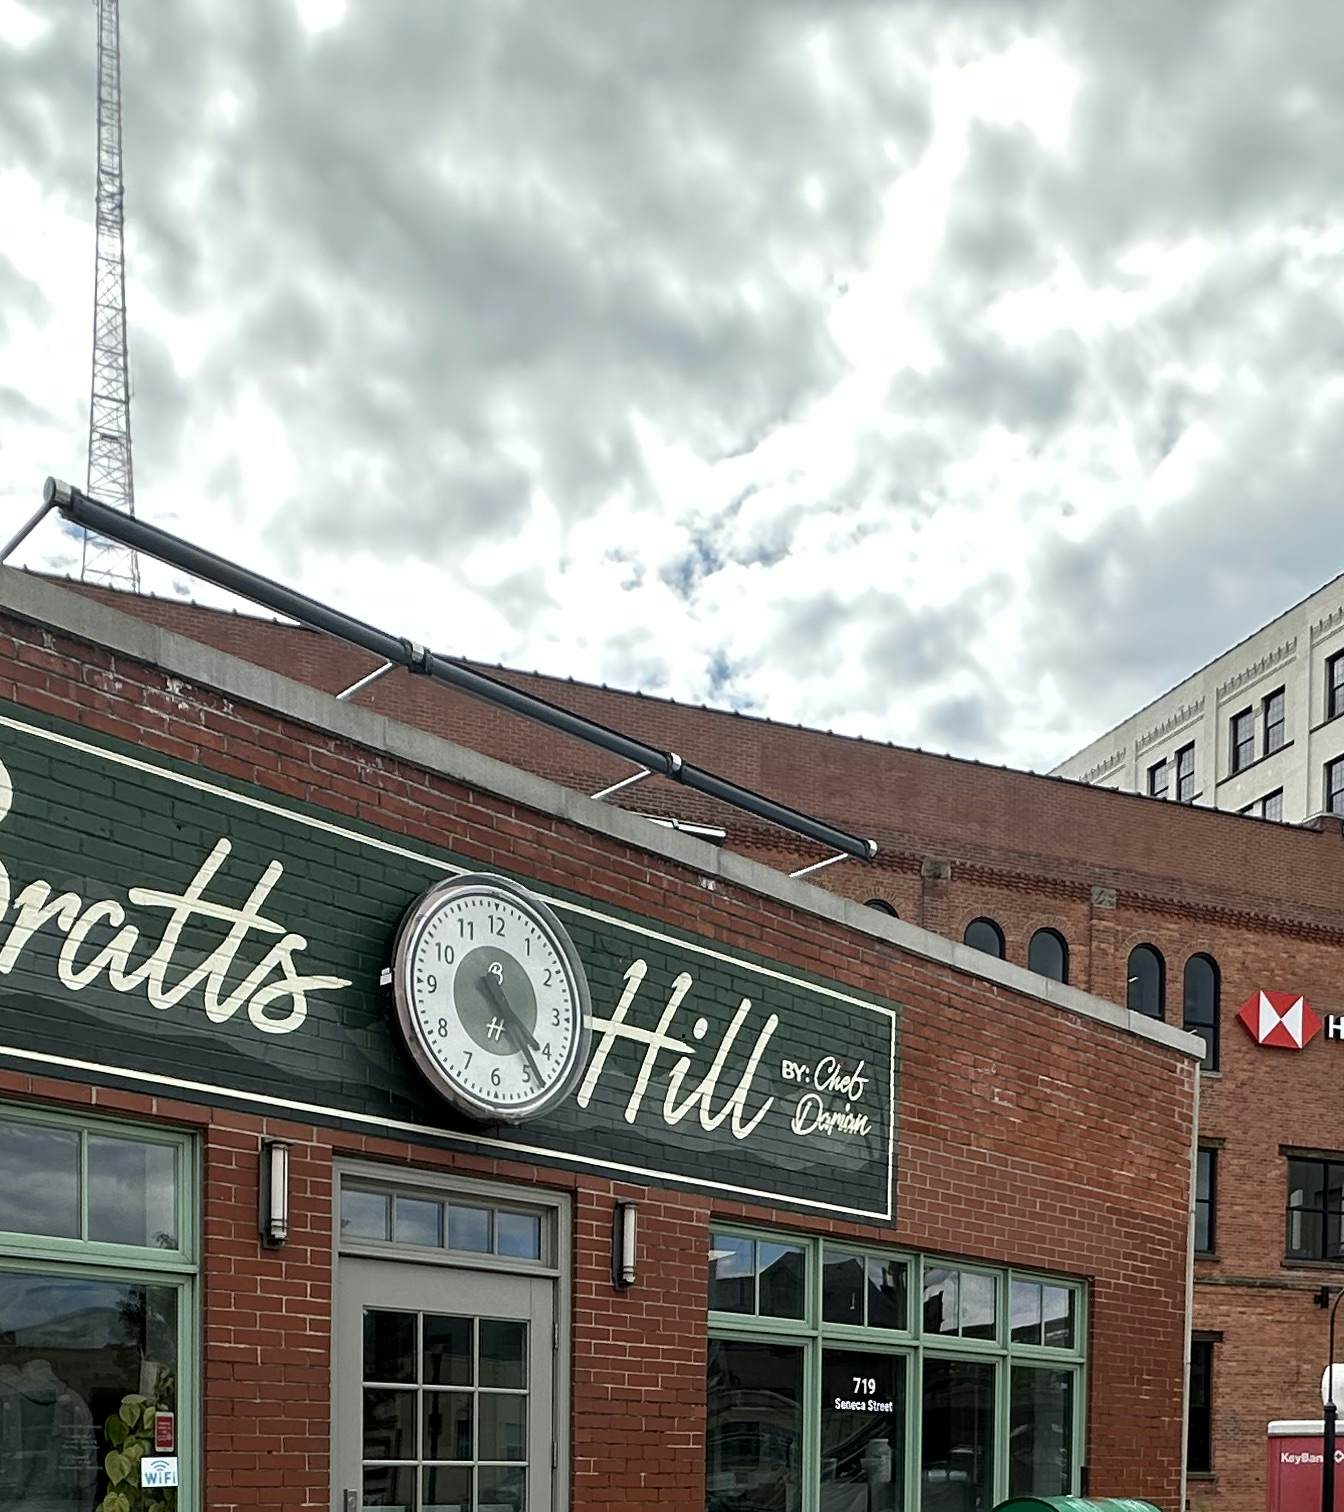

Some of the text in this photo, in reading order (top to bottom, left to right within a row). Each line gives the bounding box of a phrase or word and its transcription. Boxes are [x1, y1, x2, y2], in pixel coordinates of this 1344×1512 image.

[458, 918, 474, 940] 11
[488, 914, 506, 937] 12
[435, 942, 455, 965] 10
[525, 938, 532, 957] 1
[427, 975, 438, 994] 9
[544, 968, 553, 988] 2
[552, 1008, 561, 1027] 3
[438, 1018, 449, 1038] 8
[486, 1016, 506, 1041] H
[542, 1042, 553, 1061] 4
[577, 959, 779, 1139] Hill
[463, 1051, 473, 1070] 7
[491, 1068, 502, 1087] 6
[522, 1064, 532, 1083] 5
[782, 1056, 869, 1101] BY: Chef
[852, 1376, 876, 1395] 719
[834, 1397, 893, 1412] Seneca Street
[1281, 1452, 1325, 1464] KeyBan
